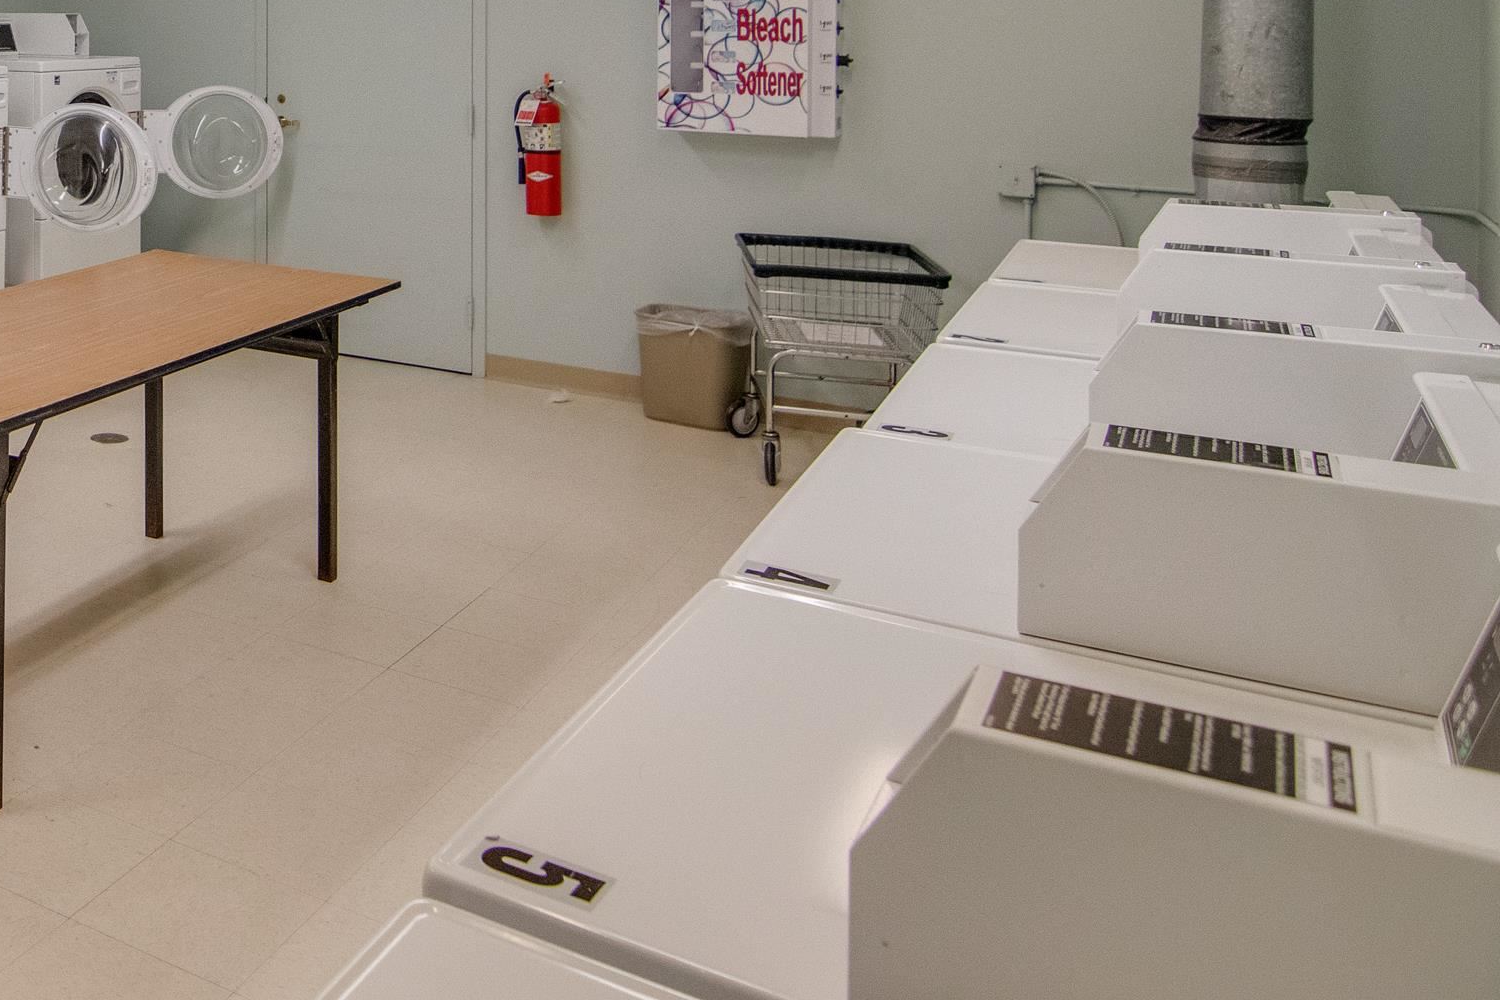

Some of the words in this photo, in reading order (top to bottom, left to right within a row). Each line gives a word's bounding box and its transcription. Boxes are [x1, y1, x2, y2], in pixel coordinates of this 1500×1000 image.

[736, 8, 803, 43] Bleach
[736, 62, 804, 97] Softener
[744, 566, 830, 590] 4
[481, 846, 607, 902] 5
